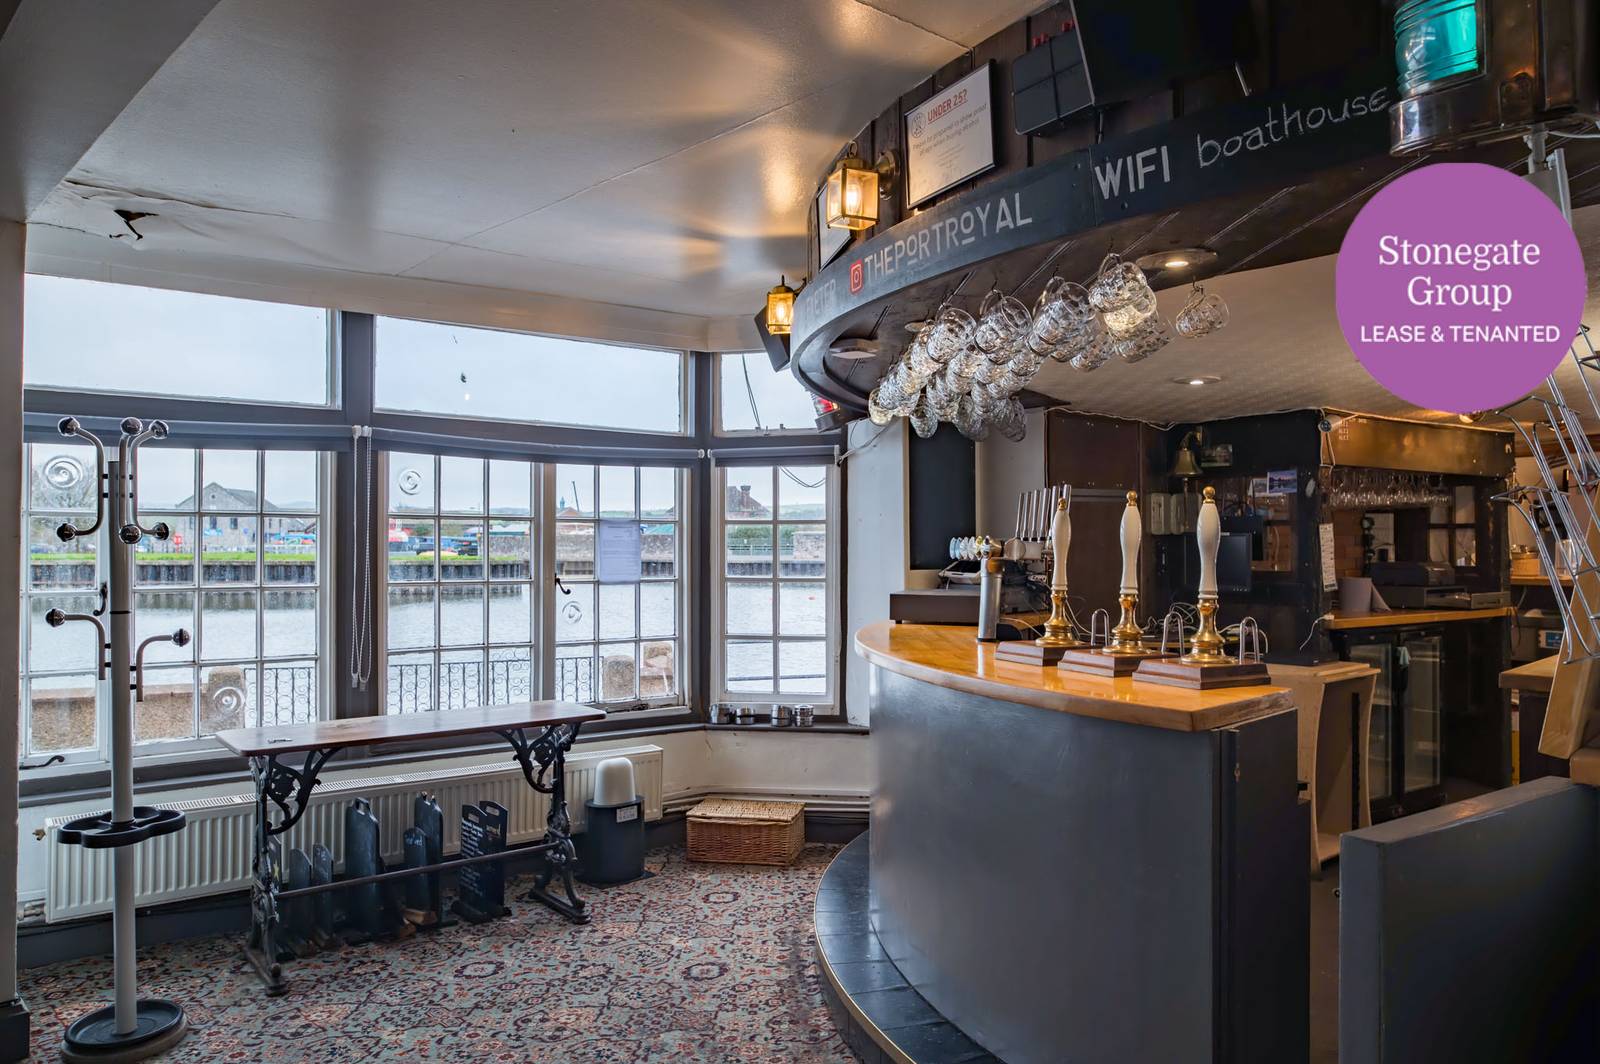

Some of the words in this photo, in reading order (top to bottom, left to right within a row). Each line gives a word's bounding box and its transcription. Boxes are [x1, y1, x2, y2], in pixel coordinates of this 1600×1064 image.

[928, 99, 952, 122] UNDER
[953, 88, 968, 107] 25?
[1094, 145, 1171, 200] WIFI
[1196, 87, 1392, 168] boathouse
